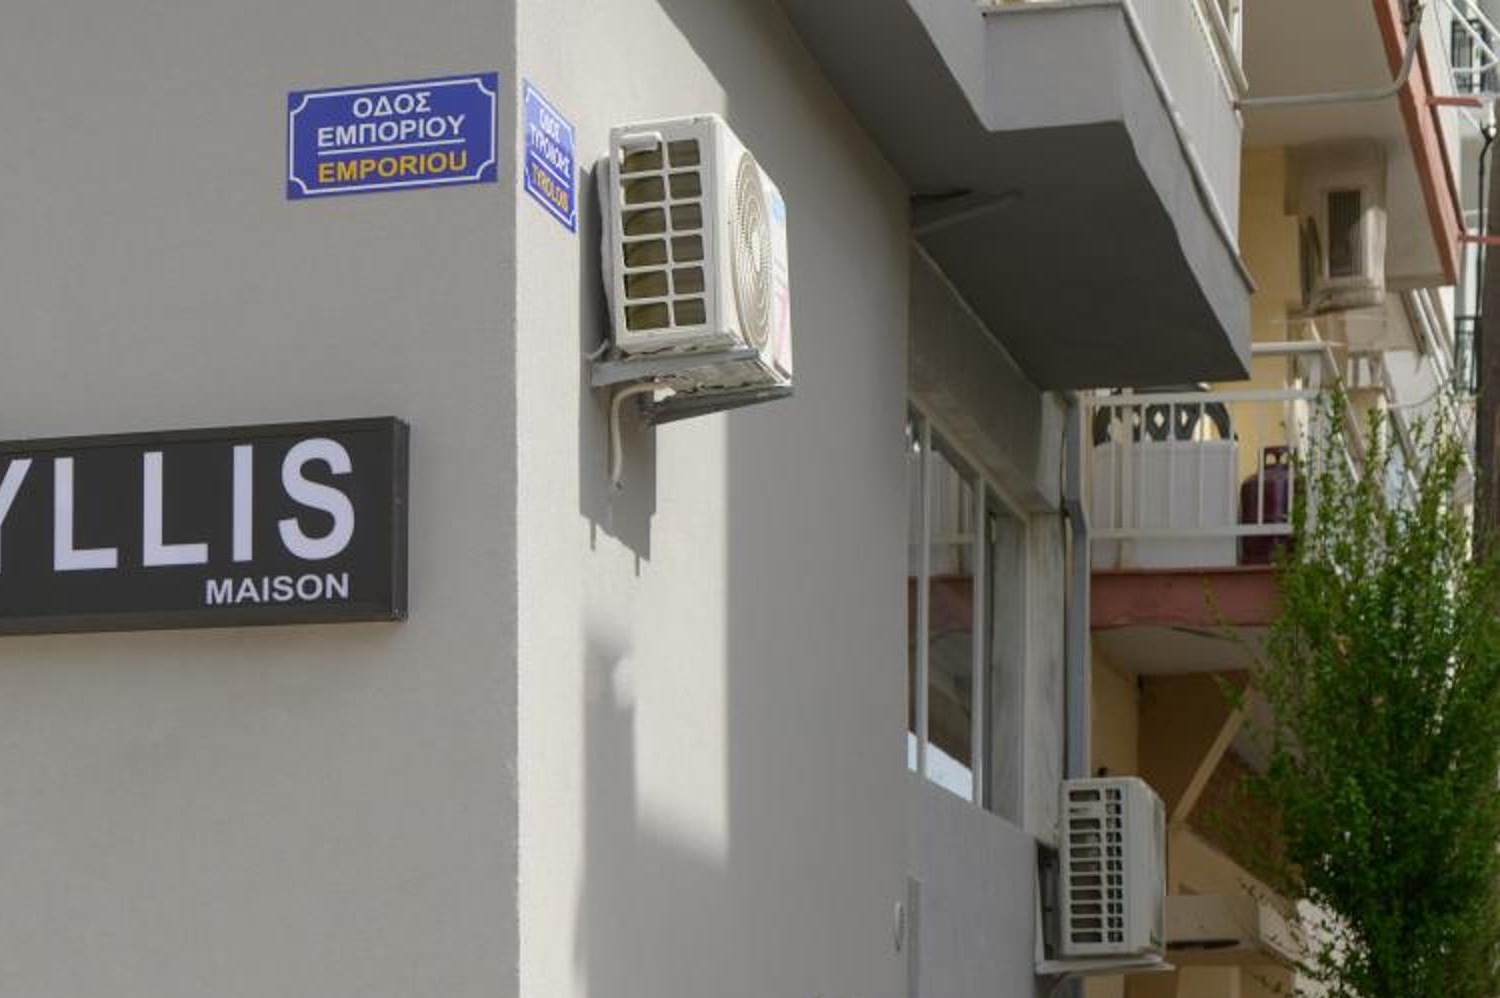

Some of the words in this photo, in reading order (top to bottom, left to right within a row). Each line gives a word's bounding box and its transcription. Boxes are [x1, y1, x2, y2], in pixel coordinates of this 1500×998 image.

[353, 91, 431, 118] ΟΔΟΣ
[317, 114, 465, 148] ΕΜΠΟΡΙΟΥ
[318, 150, 467, 184] EMPORIOU
[206, 574, 349, 605] MAISON
